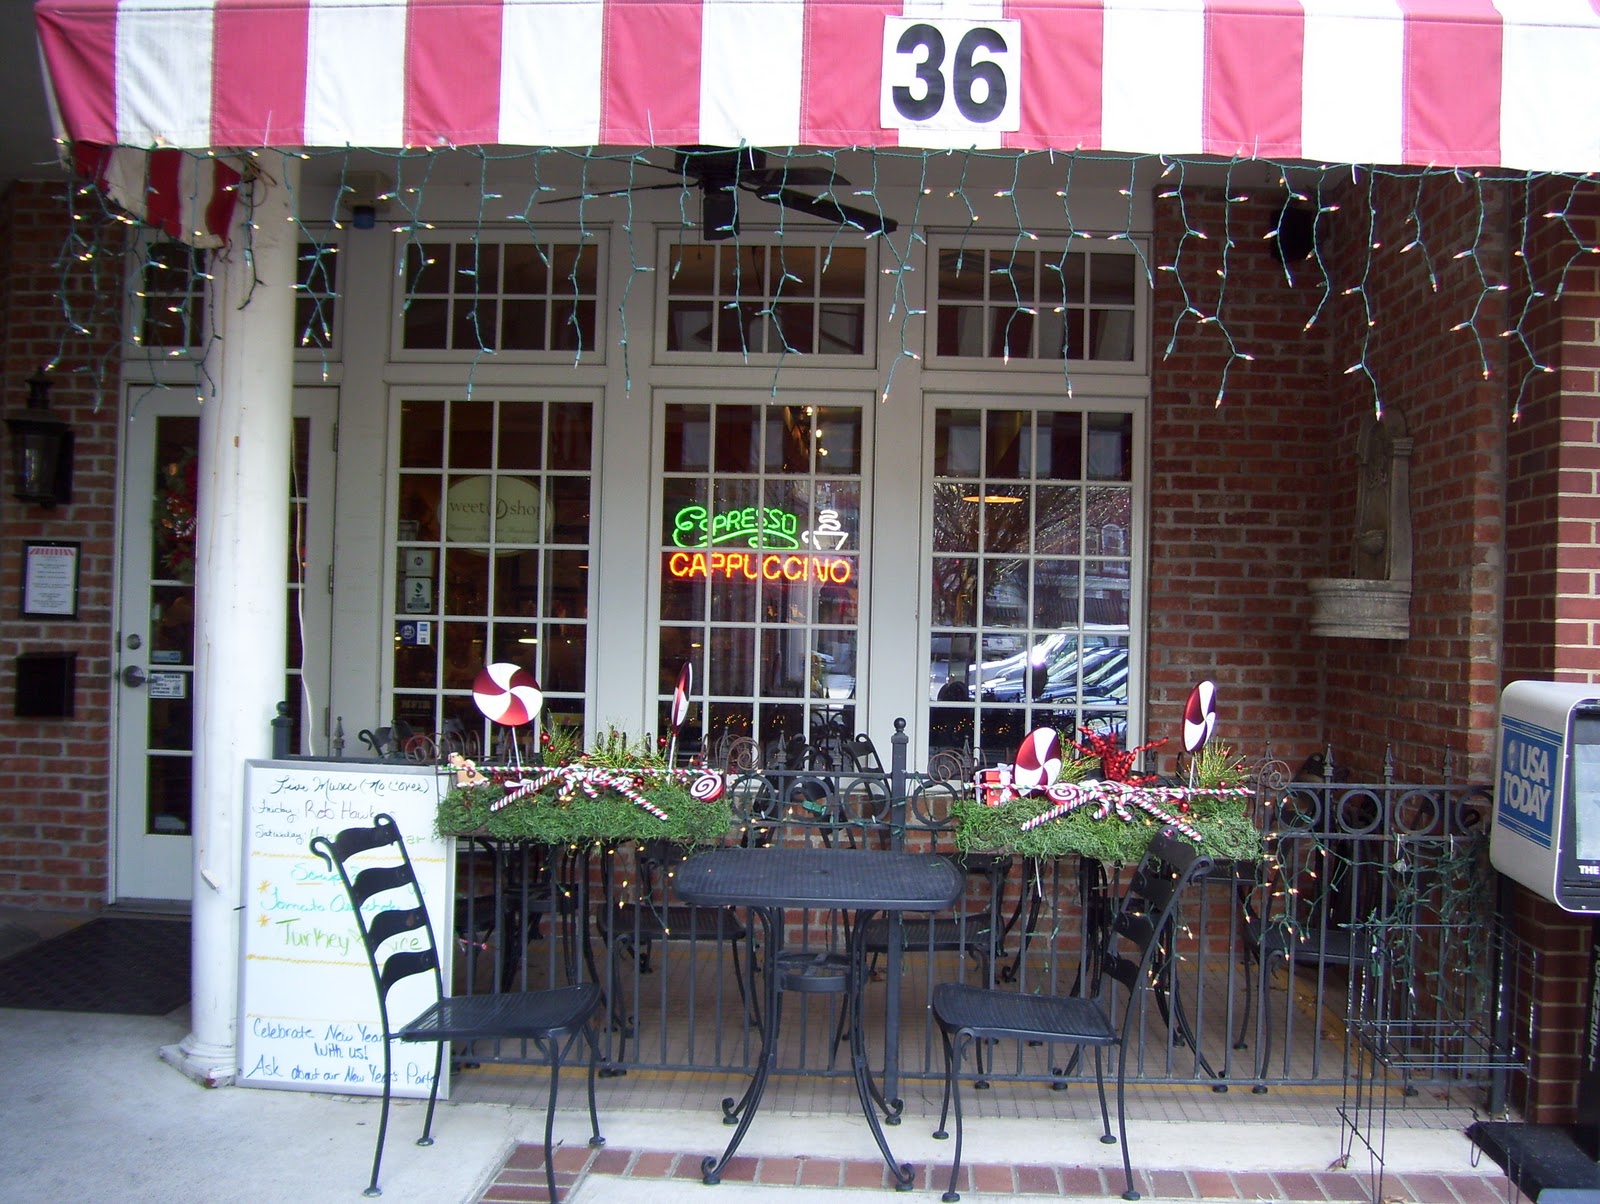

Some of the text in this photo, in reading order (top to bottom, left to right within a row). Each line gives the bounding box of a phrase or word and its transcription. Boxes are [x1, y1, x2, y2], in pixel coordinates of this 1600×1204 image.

[892, 23, 1008, 124] 36
[448, 501, 485, 513] weet
[669, 552, 851, 583] CAPPUCCINO
[1519, 742, 1550, 787] USA
[270, 775, 308, 794] Live
[312, 775, 357, 800] Music
[1503, 771, 1551, 823] TODAY
[1578, 865, 1600, 876] THE
[275, 917, 350, 957] Turkey
[253, 1017, 315, 1040] Celebrate
[324, 1024, 354, 1042] New
[349, 1045, 369, 1061] us!
[246, 1054, 284, 1079] Ask
[291, 1064, 320, 1081] about
[344, 1065, 365, 1083] New
